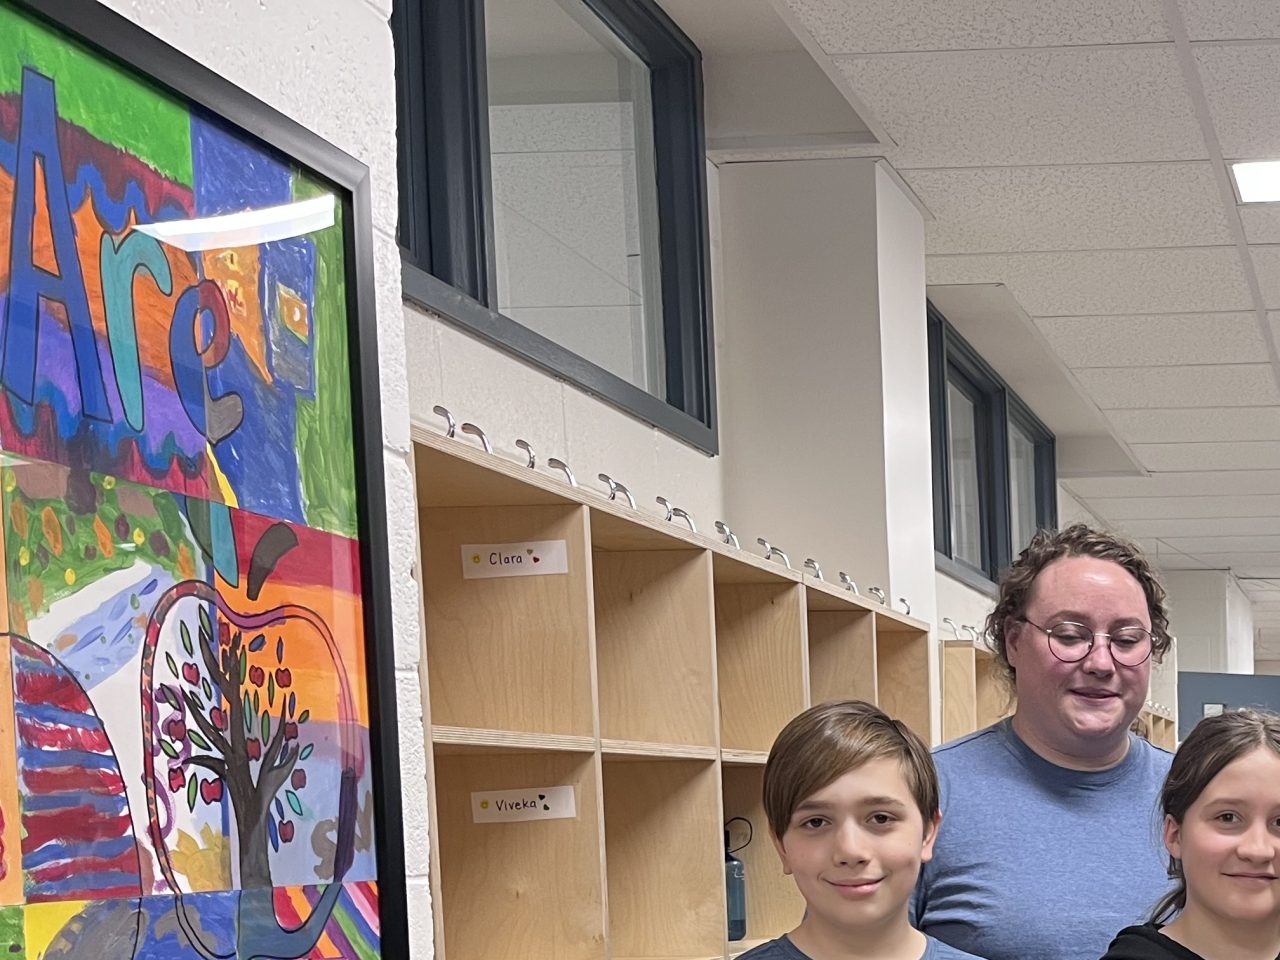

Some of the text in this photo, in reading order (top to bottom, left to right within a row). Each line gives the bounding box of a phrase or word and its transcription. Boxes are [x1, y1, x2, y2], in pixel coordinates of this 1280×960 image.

[1, 66, 244, 446] Are
[489, 552, 522, 565] Clara
[496, 798, 537, 811] Viveka
